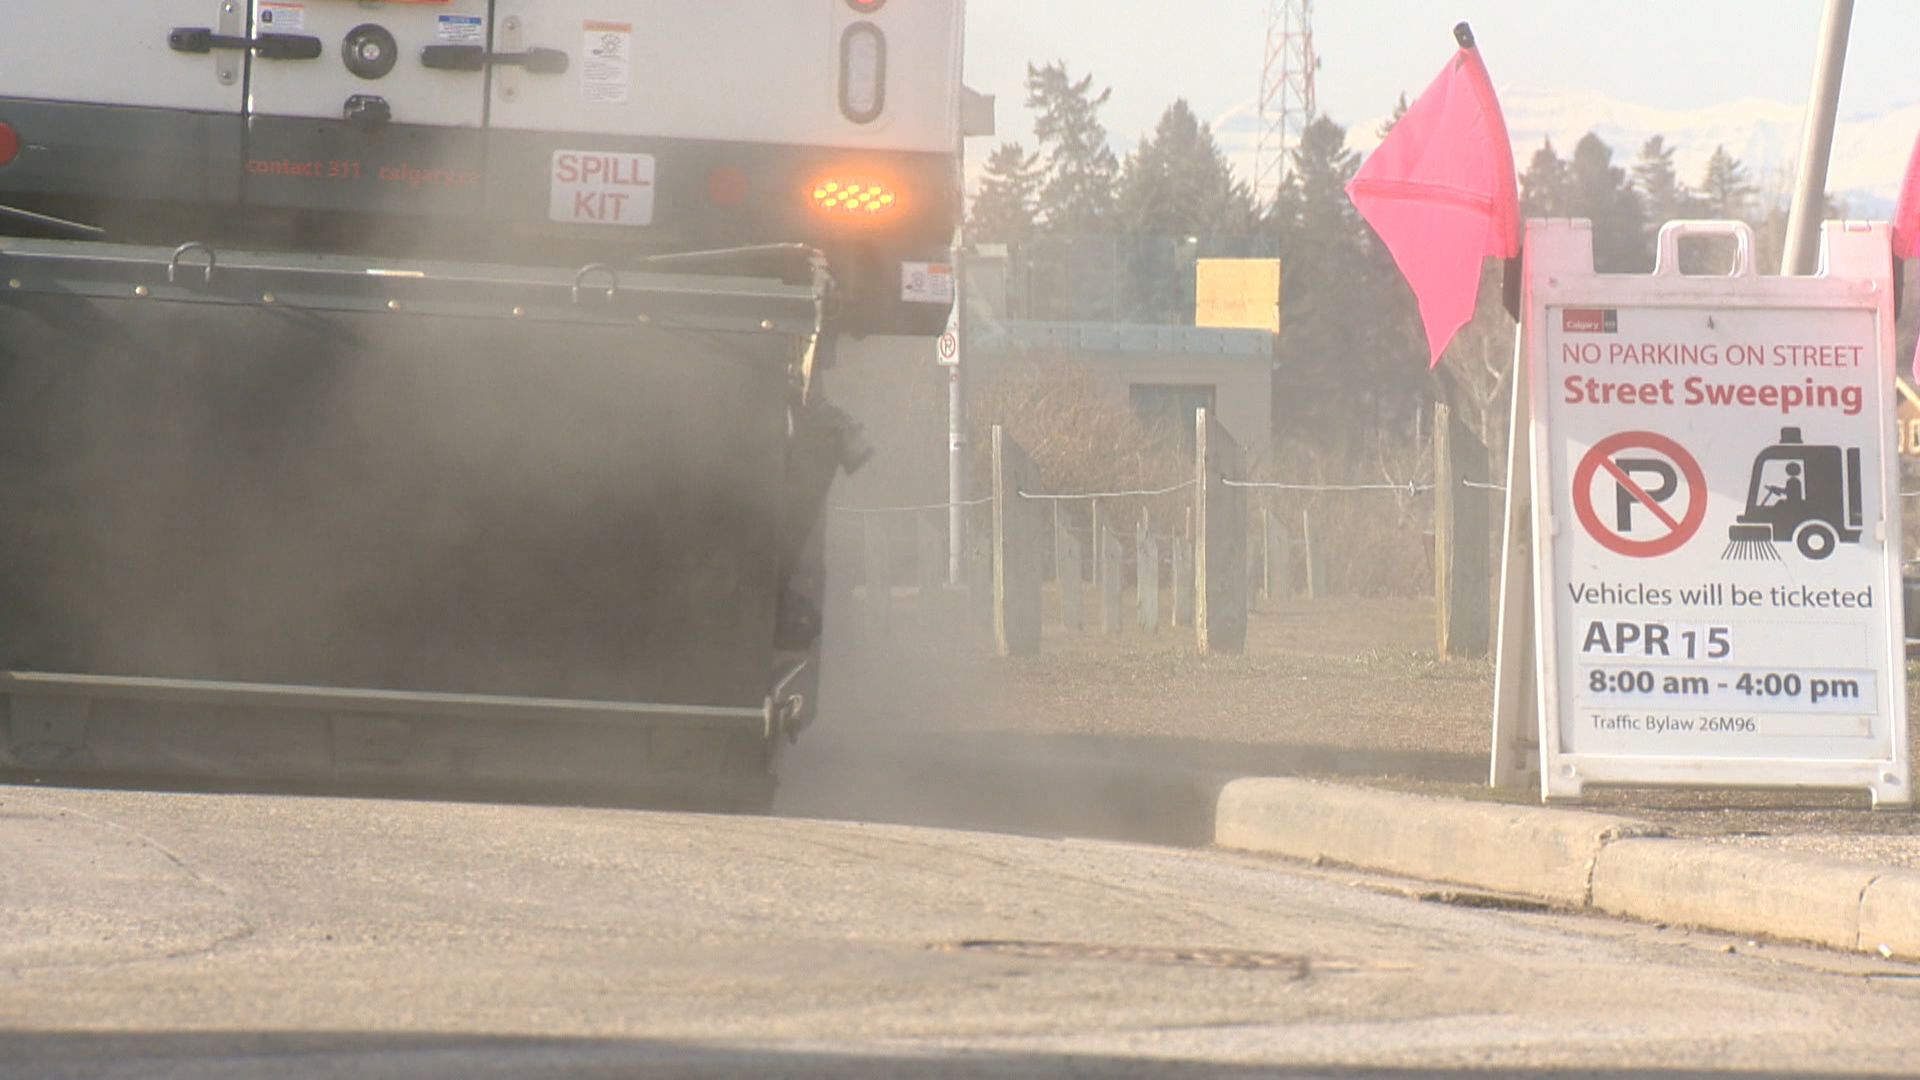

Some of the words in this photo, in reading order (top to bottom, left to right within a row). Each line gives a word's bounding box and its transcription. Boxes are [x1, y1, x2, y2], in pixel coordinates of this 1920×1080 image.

[246, 158, 321, 176] contact
[328, 160, 360, 178] 311
[556, 154, 651, 186] SPILL
[574, 191, 629, 220] KIT
[1566, 319, 1600, 331] Calgary
[1562, 343, 1601, 364] NO
[1609, 343, 1718, 365] PARKING
[1726, 344, 1764, 366] ON
[1773, 345, 1863, 367] STREET
[1564, 375, 1674, 405] Street
[1684, 376, 1863, 416] Sweeping
[1569, 583, 1672, 605] Vehicles
[1680, 584, 1723, 606] will
[1732, 585, 1763, 607] be
[1770, 585, 1873, 609] ticketed
[1582, 621, 1670, 656] APR
[1681, 627, 1731, 660] 15
[1589, 669, 1655, 693] 8:00
[1663, 675, 1709, 694] am
[1735, 672, 1802, 697] 4:00
[1810, 677, 1859, 703] pm
[1591, 715, 1641, 730] Traffic
[1646, 715, 1694, 733] Bylaw
[1699, 716, 1756, 732] 26M96
